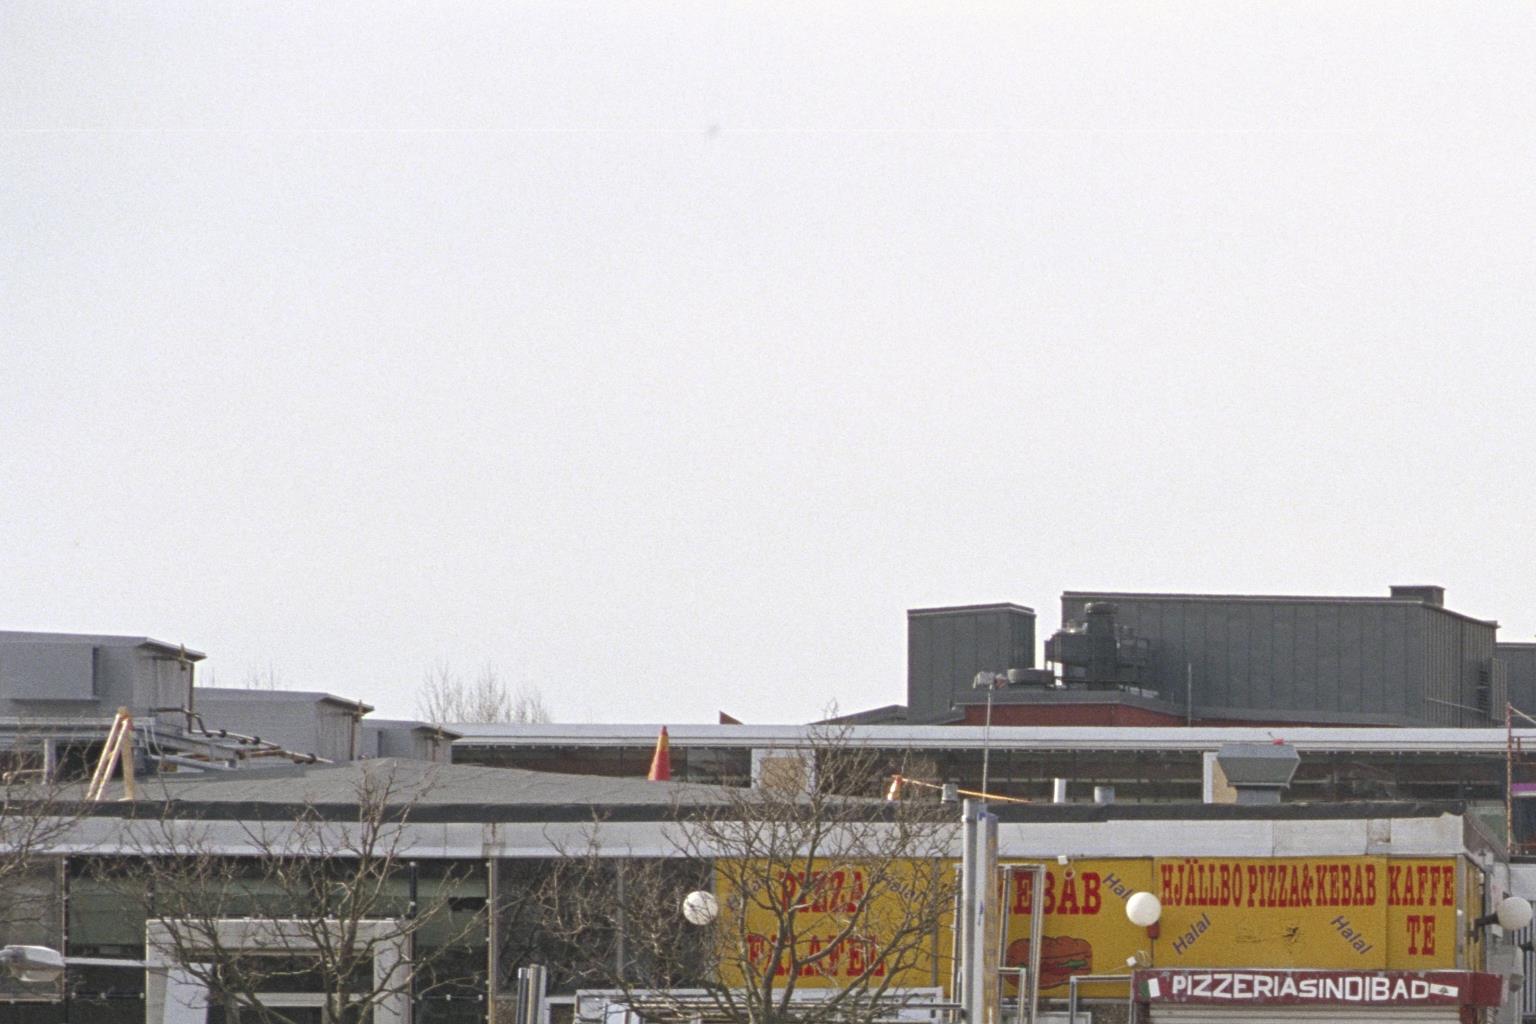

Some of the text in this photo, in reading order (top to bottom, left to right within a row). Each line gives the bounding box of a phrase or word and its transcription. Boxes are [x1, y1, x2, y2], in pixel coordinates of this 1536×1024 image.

[998, 871, 1102, 915] EBAB
[1102, 872, 1133, 900] Hal
[1160, 859, 1243, 907] HJÄLLBO
[1387, 865, 1455, 906] KAFFE
[1172, 912, 1212, 955] Halal
[1330, 915, 1373, 956] Halal
[1406, 915, 1436, 956] TE
